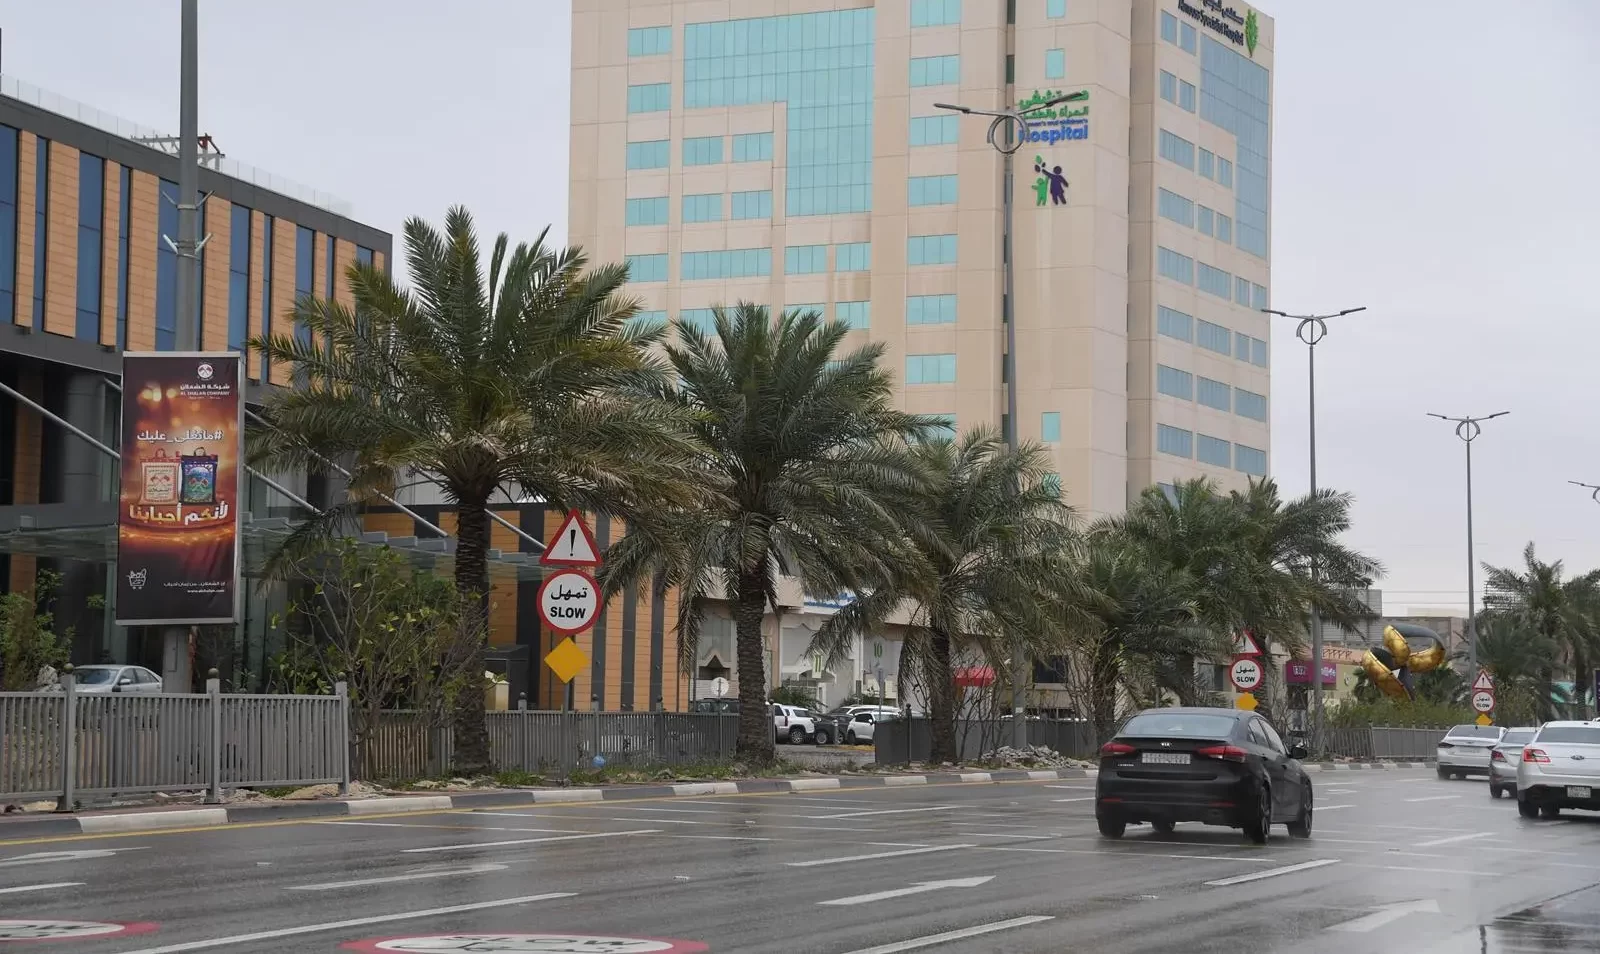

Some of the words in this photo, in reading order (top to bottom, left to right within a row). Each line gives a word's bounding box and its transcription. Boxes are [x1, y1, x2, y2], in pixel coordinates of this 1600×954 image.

[1223, 23, 1244, 46] Hospital
[129, 502, 182, 524] أحبابنا
[184, 500, 229, 525] لأنكم
[551, 584, 588, 600] تمهل
[550, 606, 586, 619] SLOW
[1236, 665, 1255, 674] تمهل
